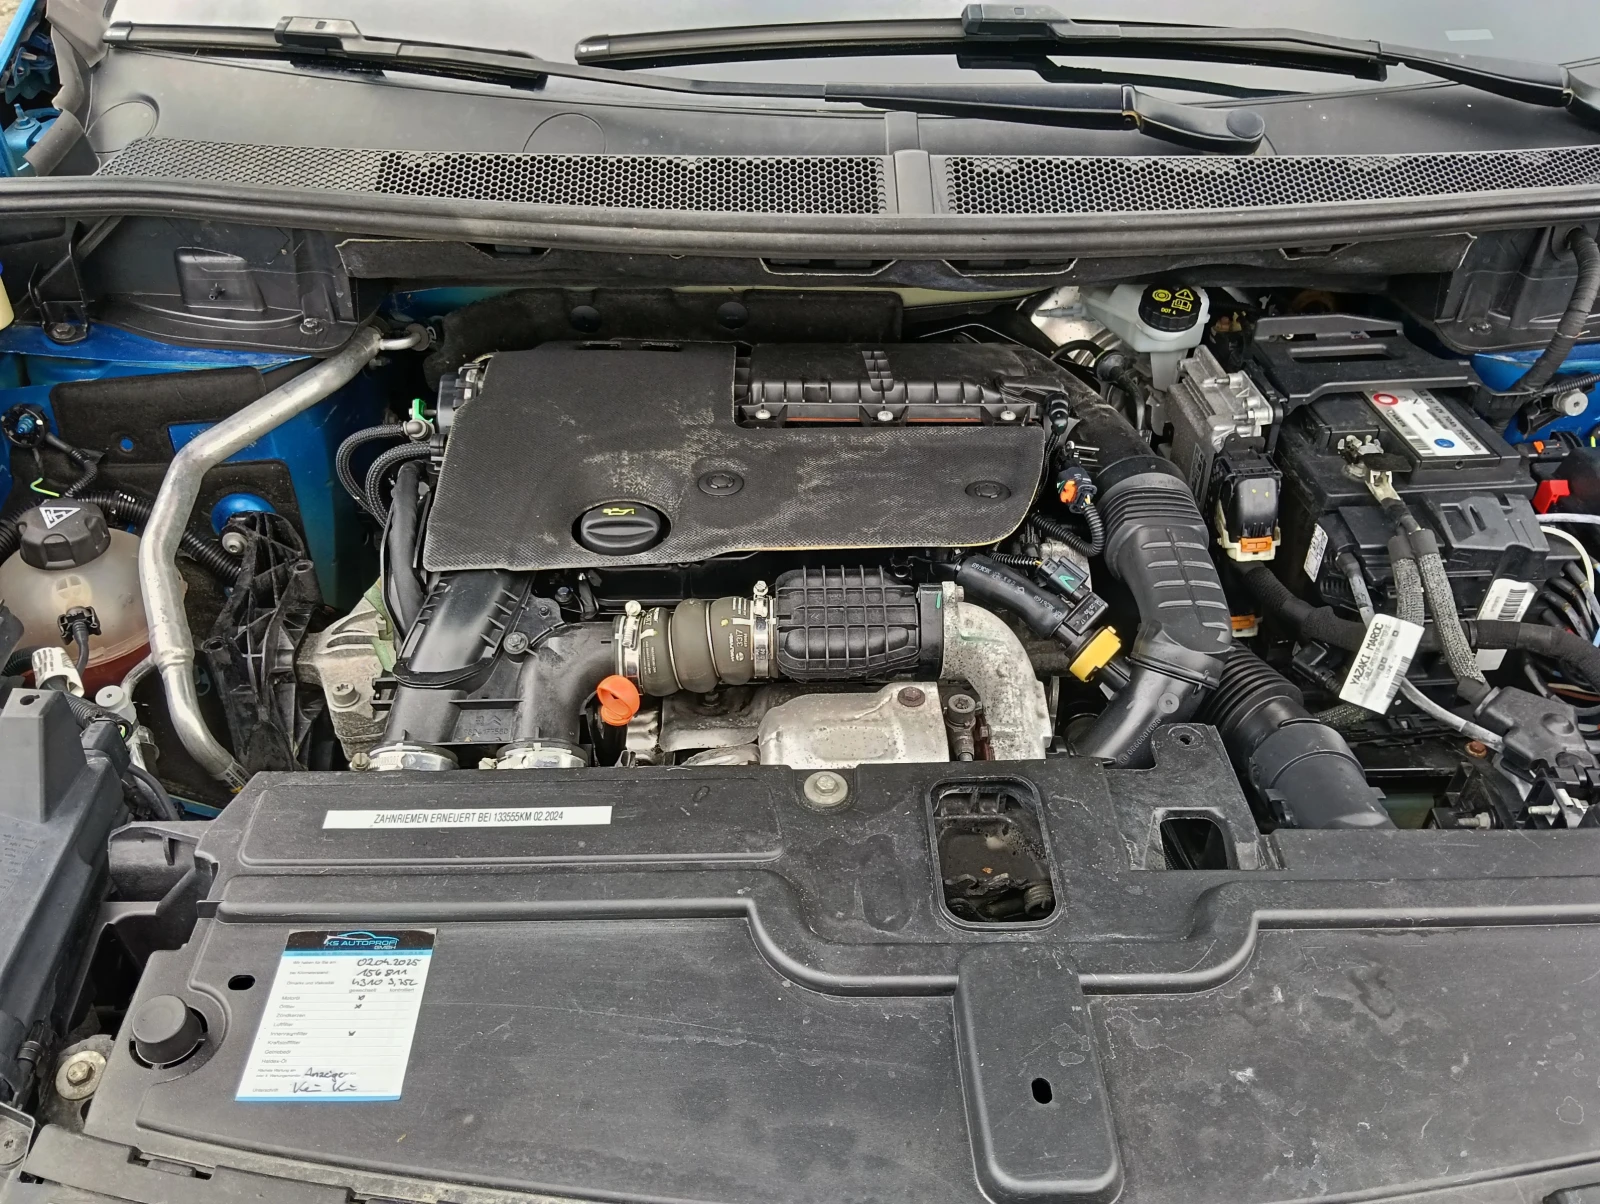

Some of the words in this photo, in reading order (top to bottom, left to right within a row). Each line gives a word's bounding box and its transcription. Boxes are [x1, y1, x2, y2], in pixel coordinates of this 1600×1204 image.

[1349, 653, 1371, 686] YAZAKI
[1365, 622, 1384, 651] MAROC
[373, 813, 429, 824] ZAHNRIEMEN
[430, 812, 476, 823] ERNEUERT
[477, 812, 491, 823] BEI
[493, 811, 532, 822] 133555KM
[533, 811, 563, 822] 02.2024
